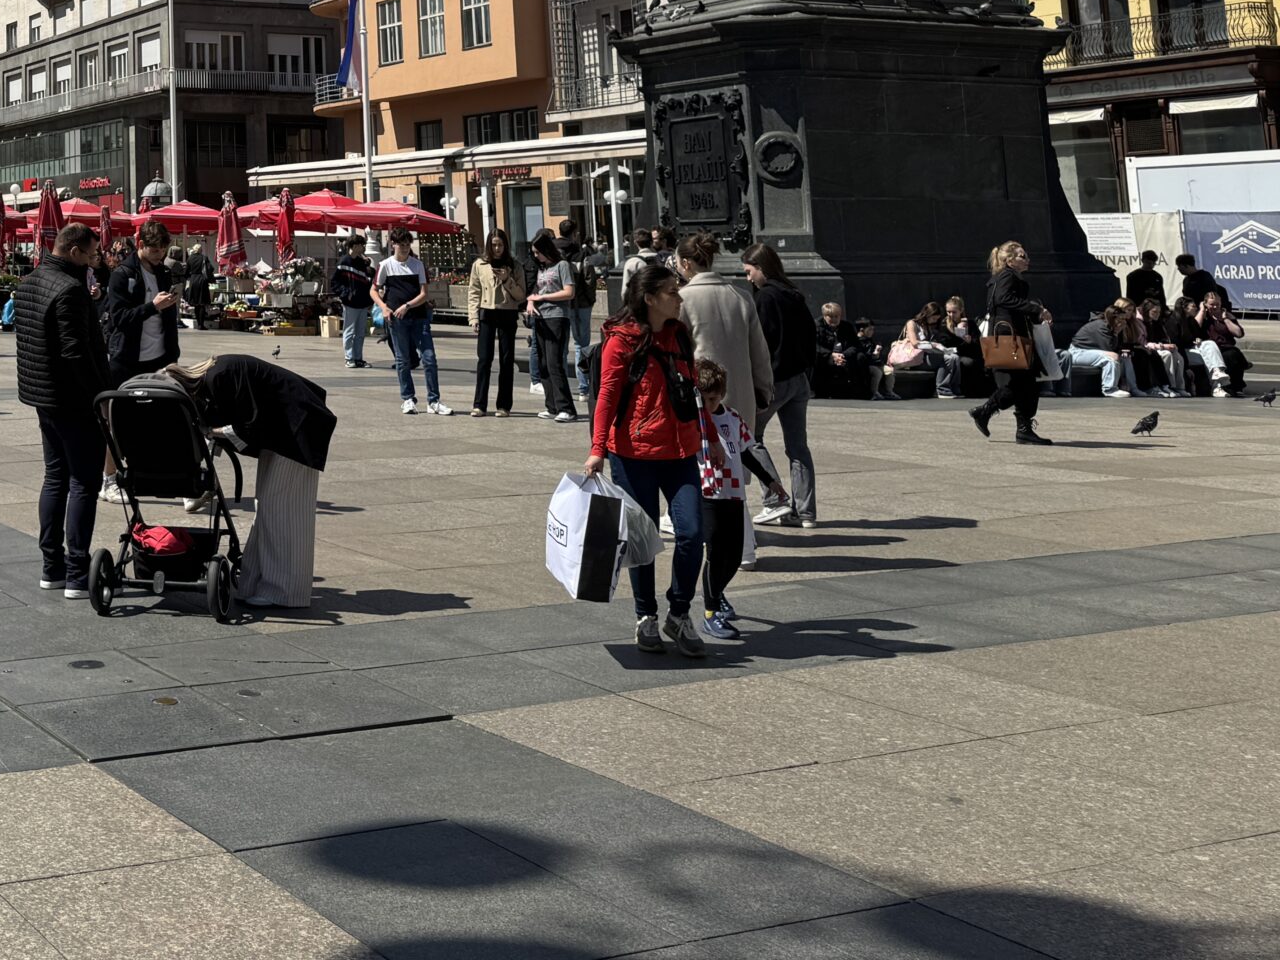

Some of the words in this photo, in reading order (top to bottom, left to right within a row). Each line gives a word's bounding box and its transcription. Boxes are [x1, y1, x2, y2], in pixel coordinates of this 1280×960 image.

[1172, 70, 1216, 89] Mala
[684, 130, 712, 154] BAN
[1214, 264, 1255, 280] AGRAD
